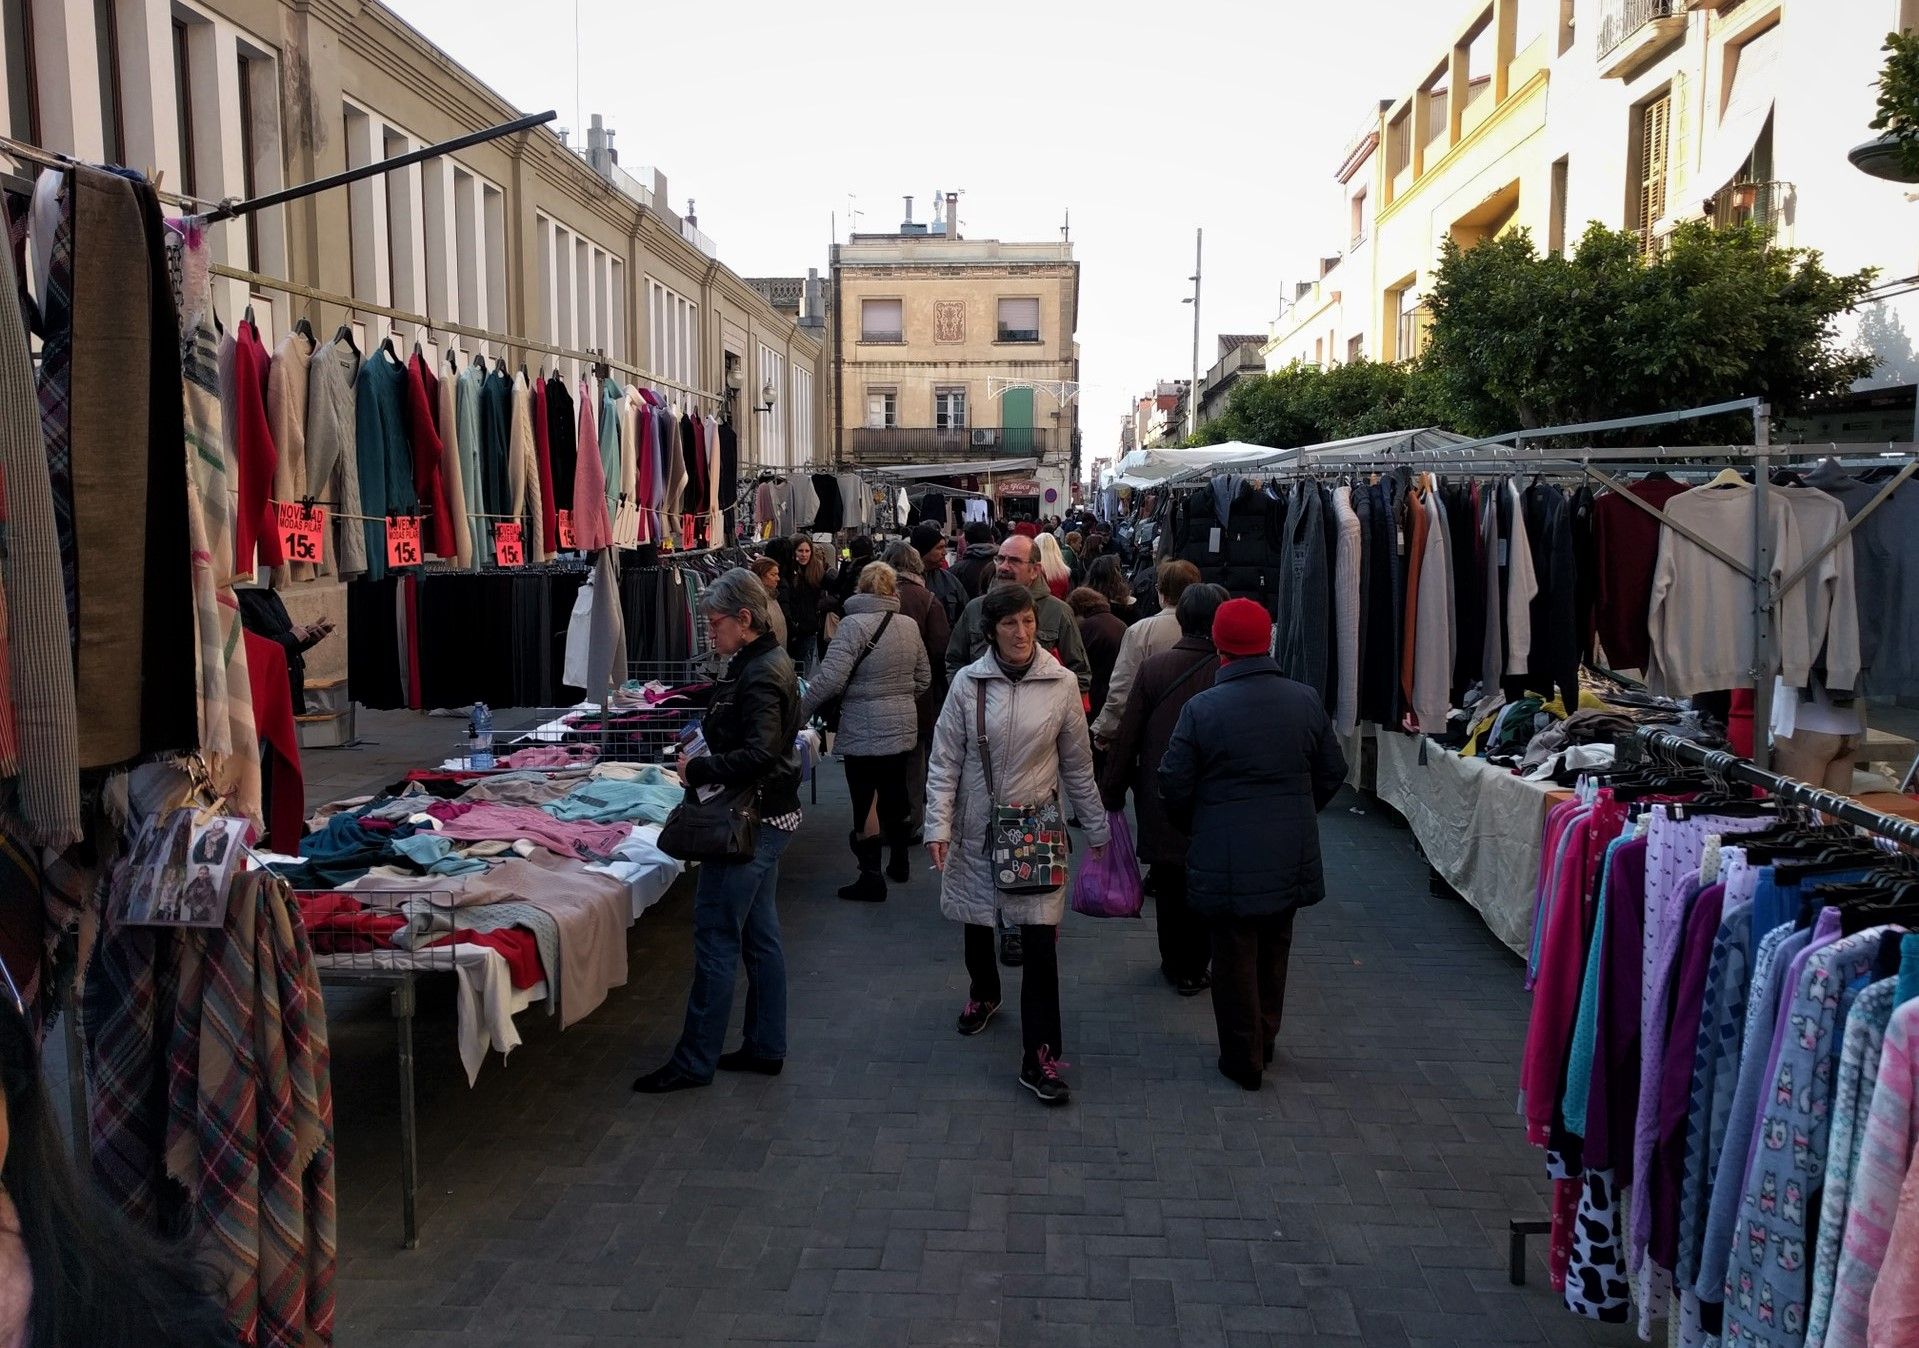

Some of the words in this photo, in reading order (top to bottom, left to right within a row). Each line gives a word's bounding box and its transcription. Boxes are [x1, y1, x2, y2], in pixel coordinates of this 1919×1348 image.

[280, 503, 323, 523] NOVEAD
[280, 518, 303, 530] MODAS
[285, 532, 316, 559] 15€
[394, 541, 417, 563] 15€
[501, 545, 519, 563] 15€
